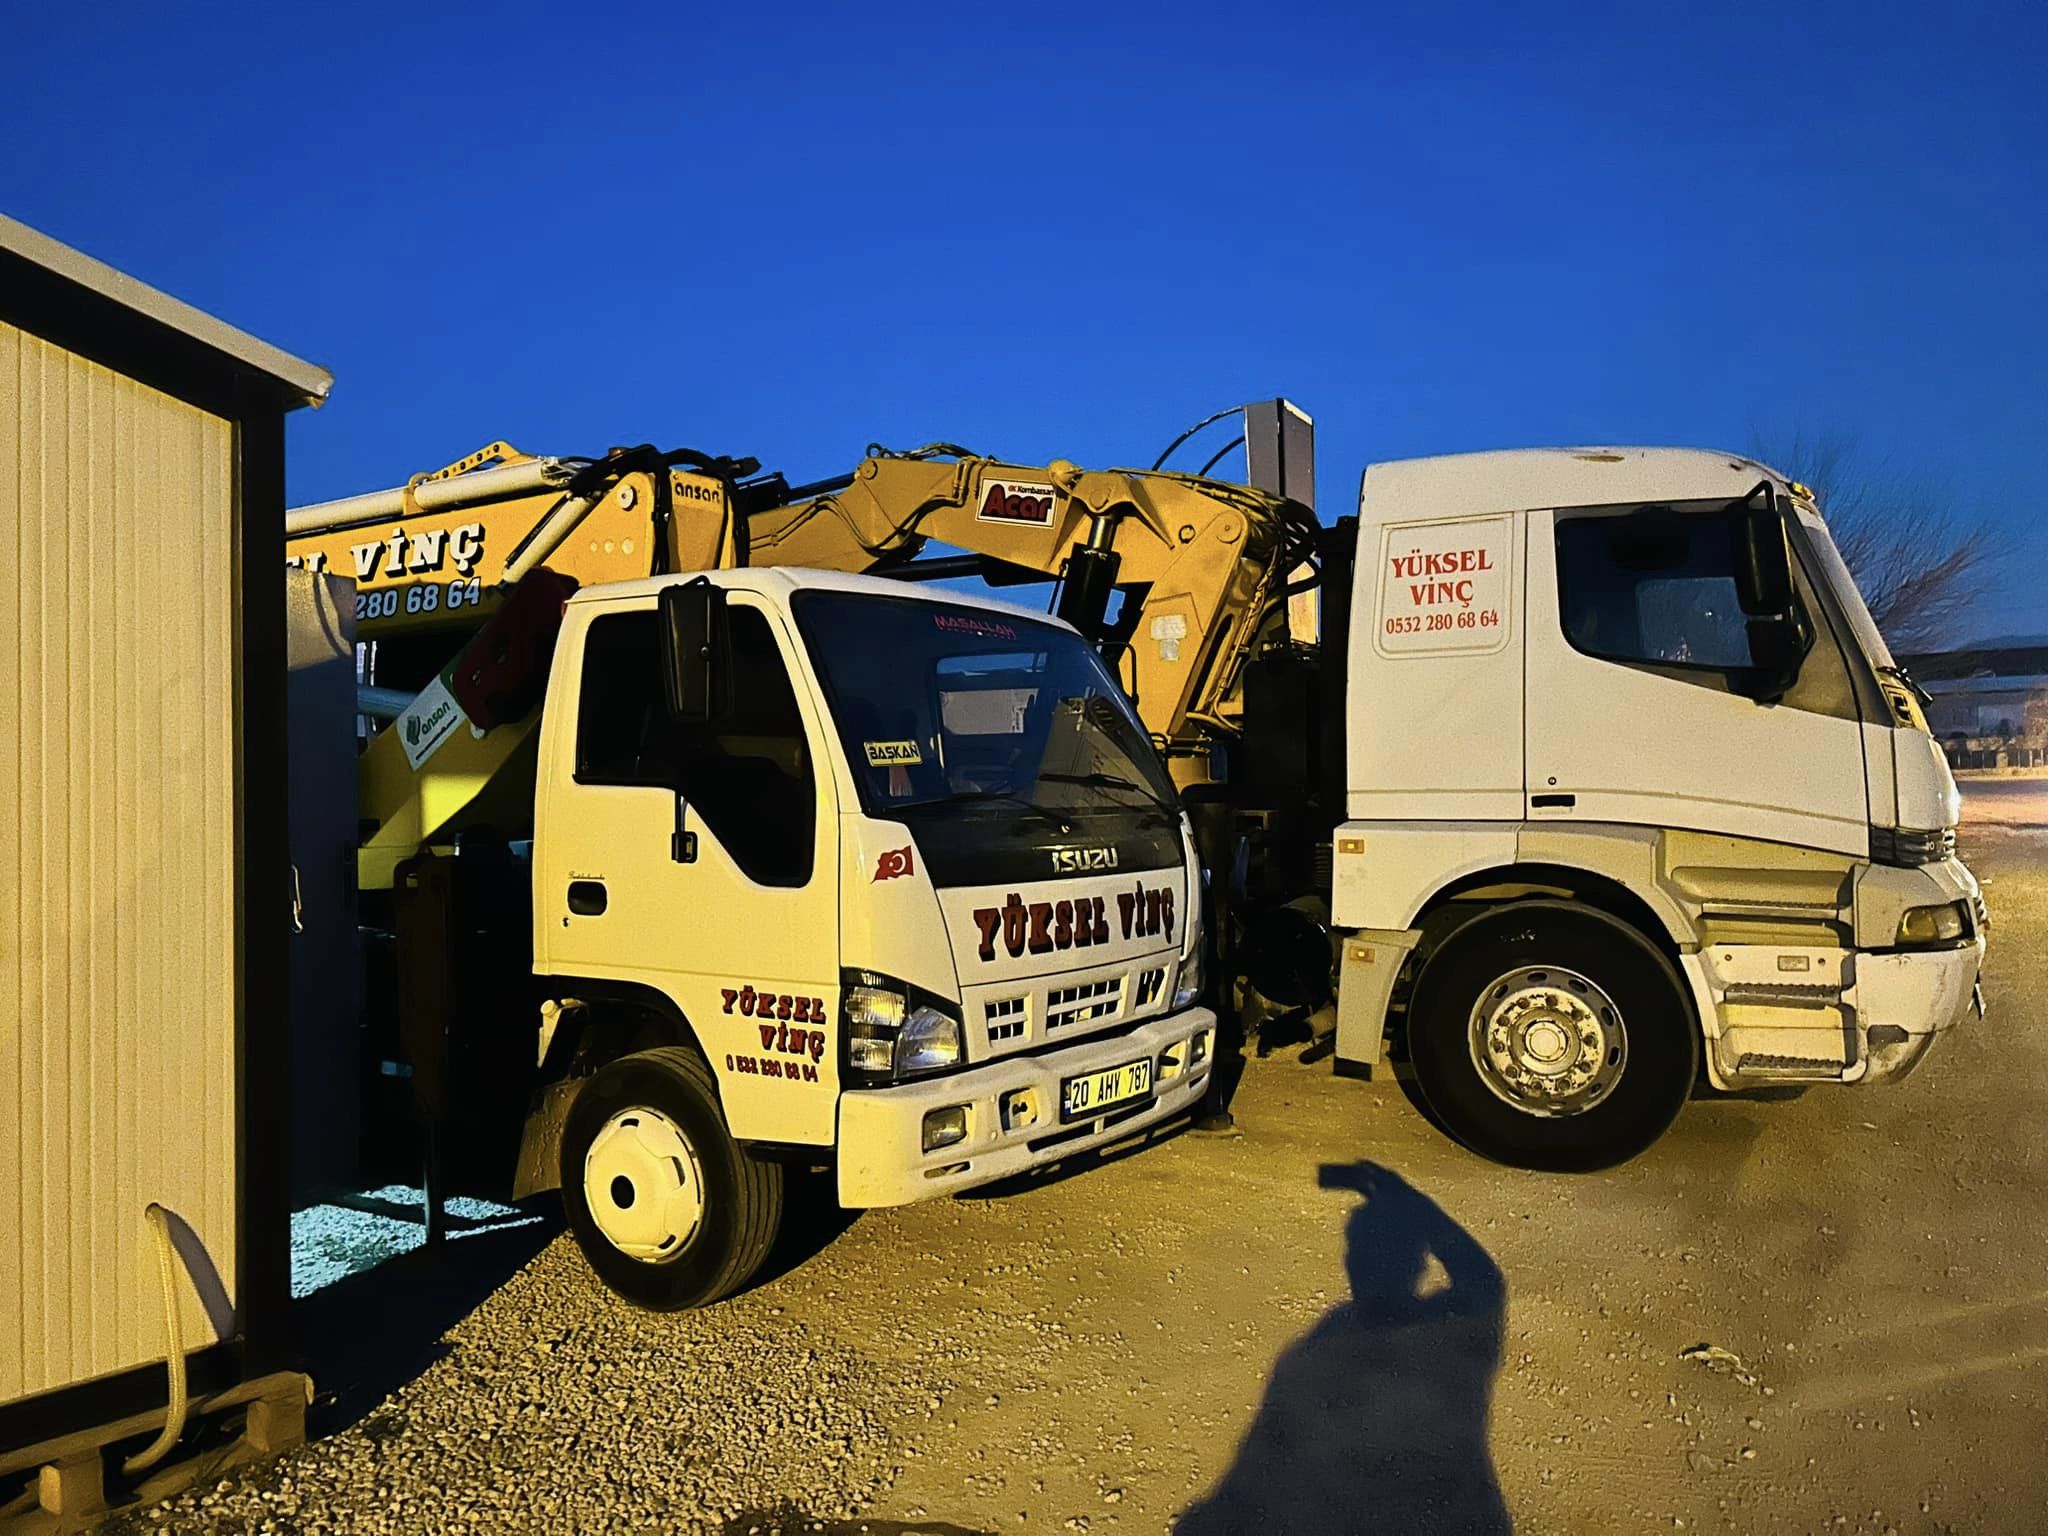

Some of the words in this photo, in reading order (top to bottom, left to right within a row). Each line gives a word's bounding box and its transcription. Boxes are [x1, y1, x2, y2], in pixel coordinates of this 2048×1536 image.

[674, 482, 720, 504] ansan
[980, 484, 1053, 522] Acar
[350, 523, 485, 582] VİNÇ
[1391, 548, 1495, 578] YÜKSEL
[356, 590, 399, 621] 280
[405, 584, 439, 615] 68
[446, 576, 482, 610] 64
[1410, 576, 1474, 608] VİNÇ
[1386, 616, 1421, 634] 0532
[1425, 613, 1453, 631] 280
[1457, 611, 1476, 629] 68
[1480, 608, 1499, 627] 64
[1052, 847, 1119, 873] ISUZU
[973, 893, 1110, 962] YÜKSEL
[1117, 880, 1175, 944] VİNÇ
[721, 985, 826, 1025] YÜKSEL
[759, 1021, 826, 1064] VİNÇ
[726, 1054, 734, 1072] 0
[1072, 1080, 1089, 1110] 20
[1128, 1063, 1148, 1093] 787
